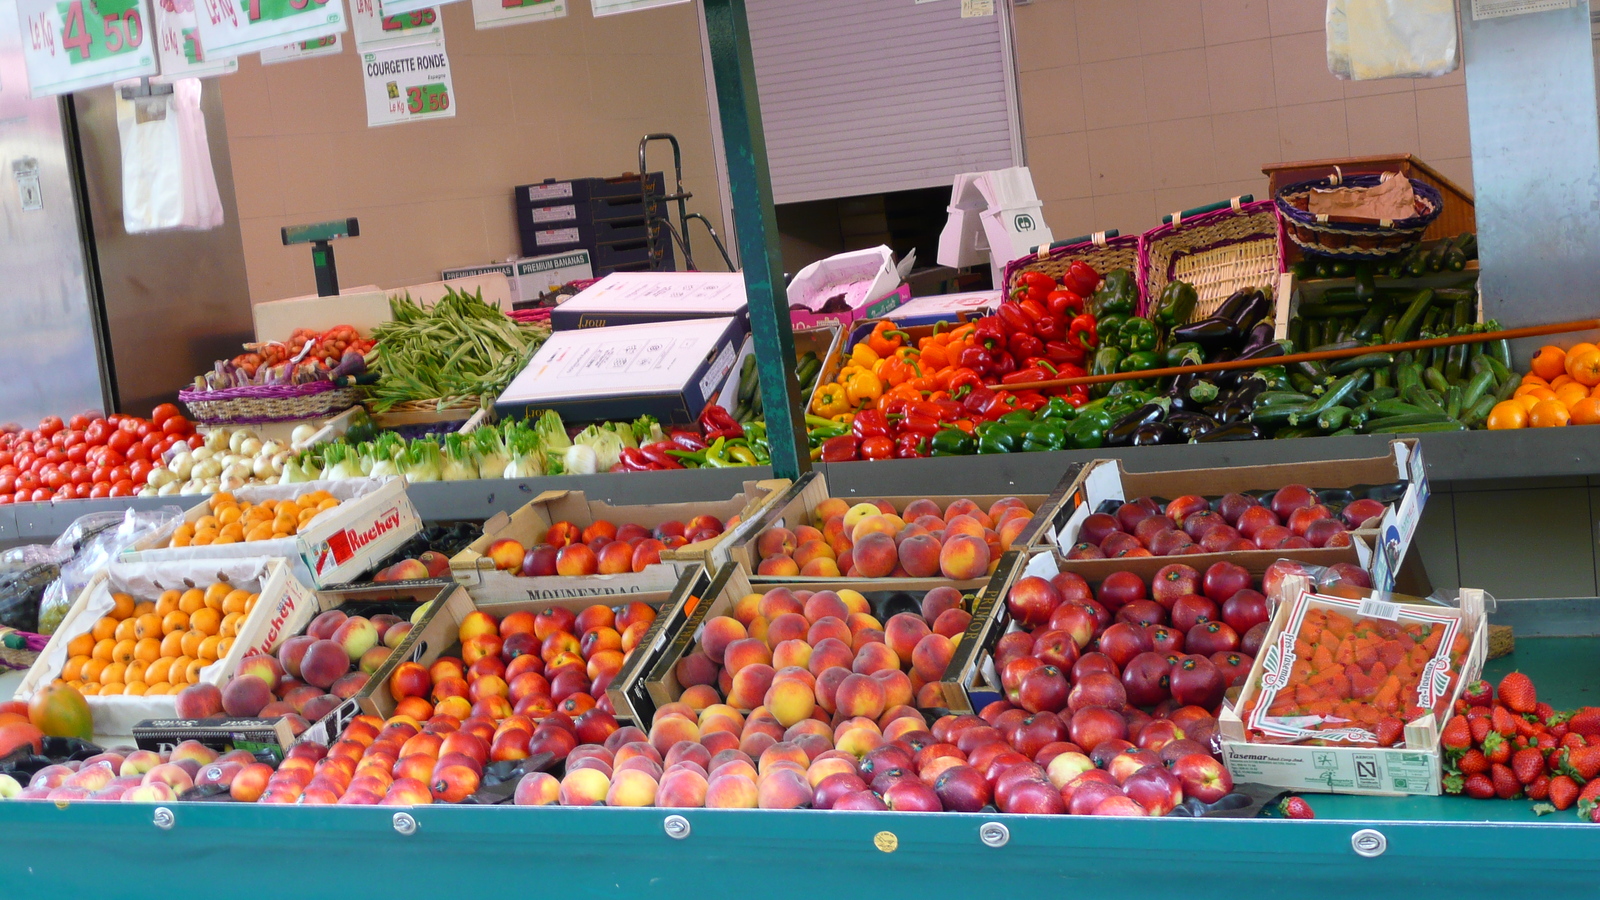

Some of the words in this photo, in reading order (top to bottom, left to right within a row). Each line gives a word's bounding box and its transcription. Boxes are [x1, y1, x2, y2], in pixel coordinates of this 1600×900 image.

[28, 14, 41, 50] Le
[62, 0, 93, 60] 4
[103, 8, 143, 52] 50
[367, 57, 415, 77] COURGETTE
[416, 54, 446, 70] RONDE
[389, 101, 396, 113] Le
[407, 86, 424, 114] 3
[429, 92, 450, 111] 50
[523, 260, 553, 274] PREMIUM
[554, 254, 585, 268] BANANAS
[346, 510, 399, 552] Ruchey
[676, 598, 715, 644] PRIMOR
[963, 590, 1000, 640] PRIMOR
[1229, 752, 1268, 760] Tasemar
